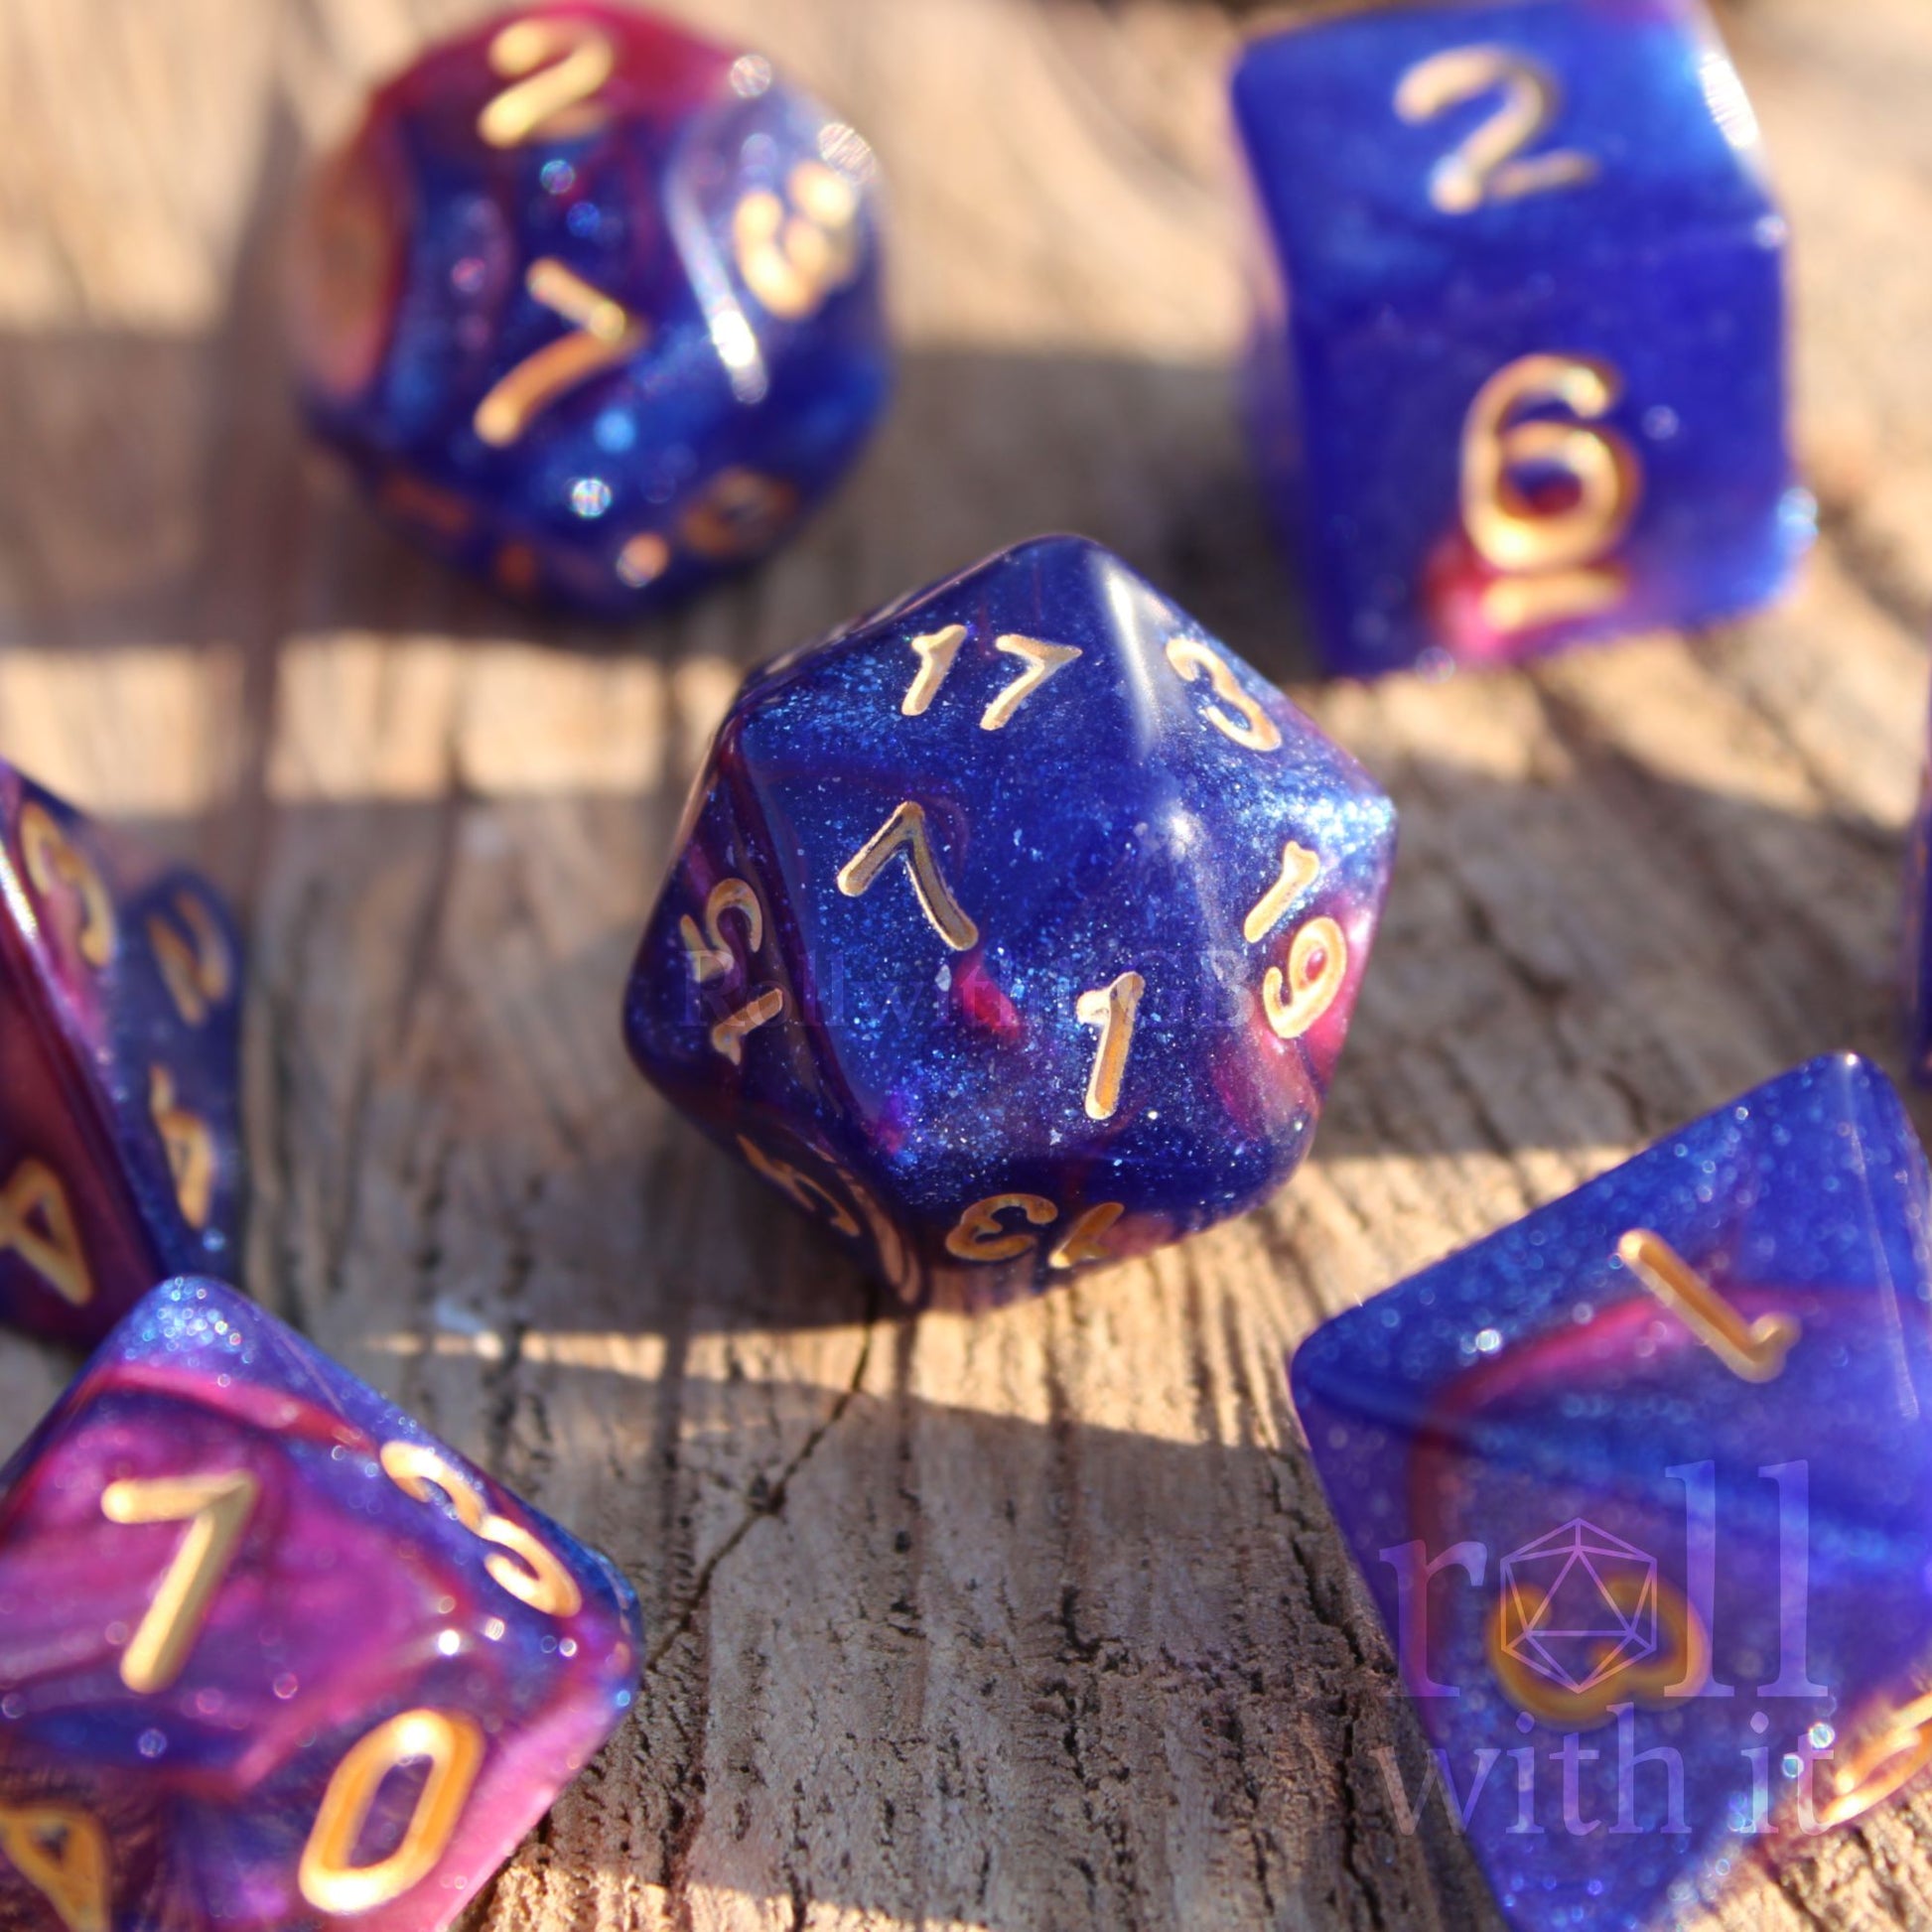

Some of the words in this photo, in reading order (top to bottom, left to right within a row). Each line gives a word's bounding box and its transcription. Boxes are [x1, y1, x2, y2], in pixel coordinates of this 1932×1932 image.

[478, 18, 613, 148] 2
[1395, 45, 1599, 214] 2
[474, 255, 646, 448] 7
[1458, 352, 1641, 574] 6
[901, 624, 1083, 732] 17
[1166, 637, 1282, 752] 3
[837, 801, 979, 951] 7
[1244, 839, 1347, 1039] 19
[1076, 971, 1145, 1121] 1
[1616, 1228, 1799, 1383] 1
[101, 1468, 258, 1694] 7
[380, 1442, 582, 1617] 3
[299, 1708, 484, 1915] 0
